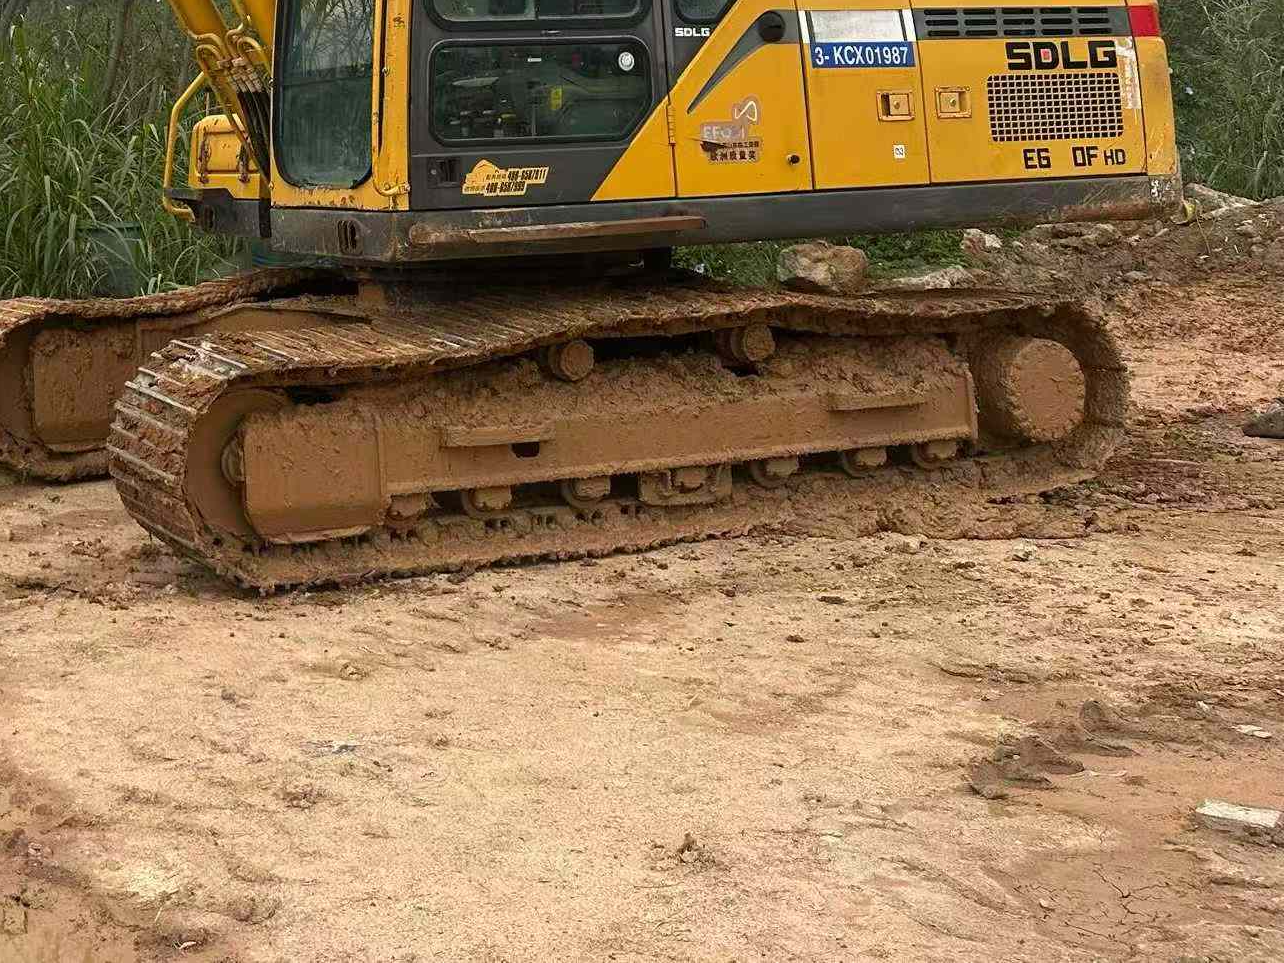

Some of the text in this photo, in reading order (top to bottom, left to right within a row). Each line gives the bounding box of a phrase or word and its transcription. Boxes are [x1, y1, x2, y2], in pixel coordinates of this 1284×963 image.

[674, 27, 710, 37] SDLG
[833, 45, 908, 65] KCX01987
[1006, 40, 1117, 70] SDLG
[1103, 148, 1126, 165] HD
